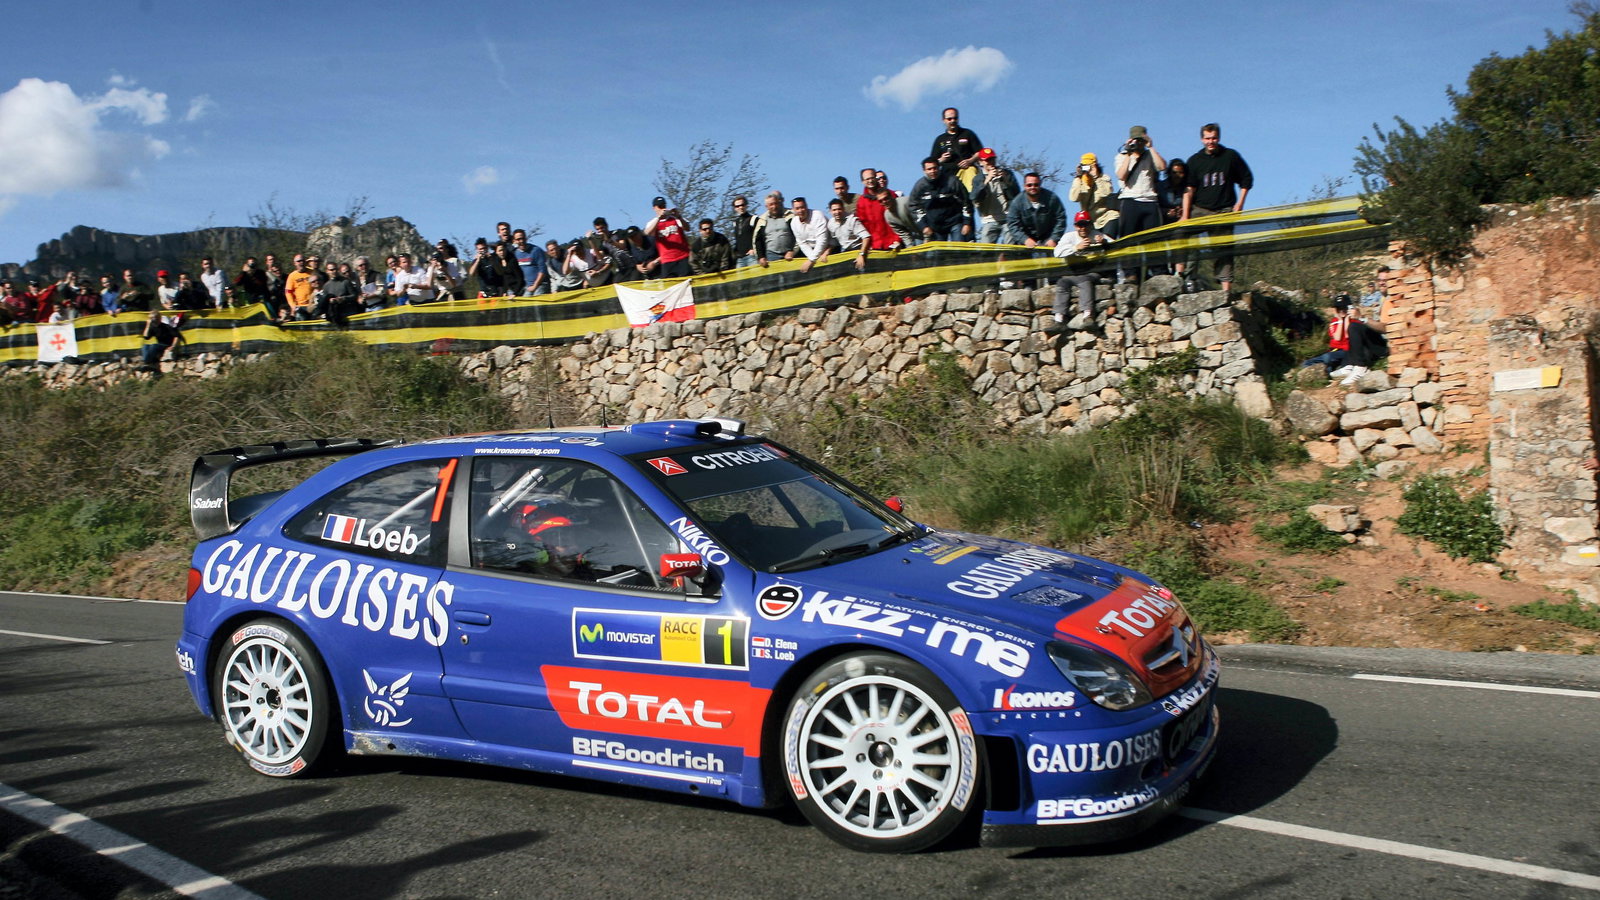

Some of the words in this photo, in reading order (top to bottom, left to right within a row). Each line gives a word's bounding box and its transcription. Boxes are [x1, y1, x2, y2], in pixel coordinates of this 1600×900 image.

[474, 447, 561, 456] www.kronosracing.com
[193, 497, 223, 509] Sabelt
[430, 458, 459, 522] 1
[354, 519, 418, 556] Loeb
[669, 516, 730, 566] NIKKO
[665, 559, 703, 569] TOTAL
[201, 540, 455, 647] GAULOISES
[664, 621, 698, 635] RACC
[859, 599, 882, 608] THE
[884, 603, 939, 619] NATURAL
[942, 616, 994, 634] ENERGY
[995, 631, 1035, 649] DRINK
[1098, 591, 1178, 637] TOTAL
[233, 626, 287, 645] BFGoodrich
[606, 631, 655, 644] movistar
[718, 620, 733, 665] 1
[764, 637, 773, 648] D.
[775, 638, 798, 650] Elena
[764, 649, 773, 659] S.
[775, 650, 795, 661] Loeb
[569, 680, 723, 729] TOTAL
[993, 683, 1076, 710] KRONOS
[573, 736, 724, 772] BFGoodrich
[951, 712, 974, 807] BFGoodrich
[1026, 727, 1162, 774] GAULOISES
[1037, 783, 1160, 818] BFGoodrich
